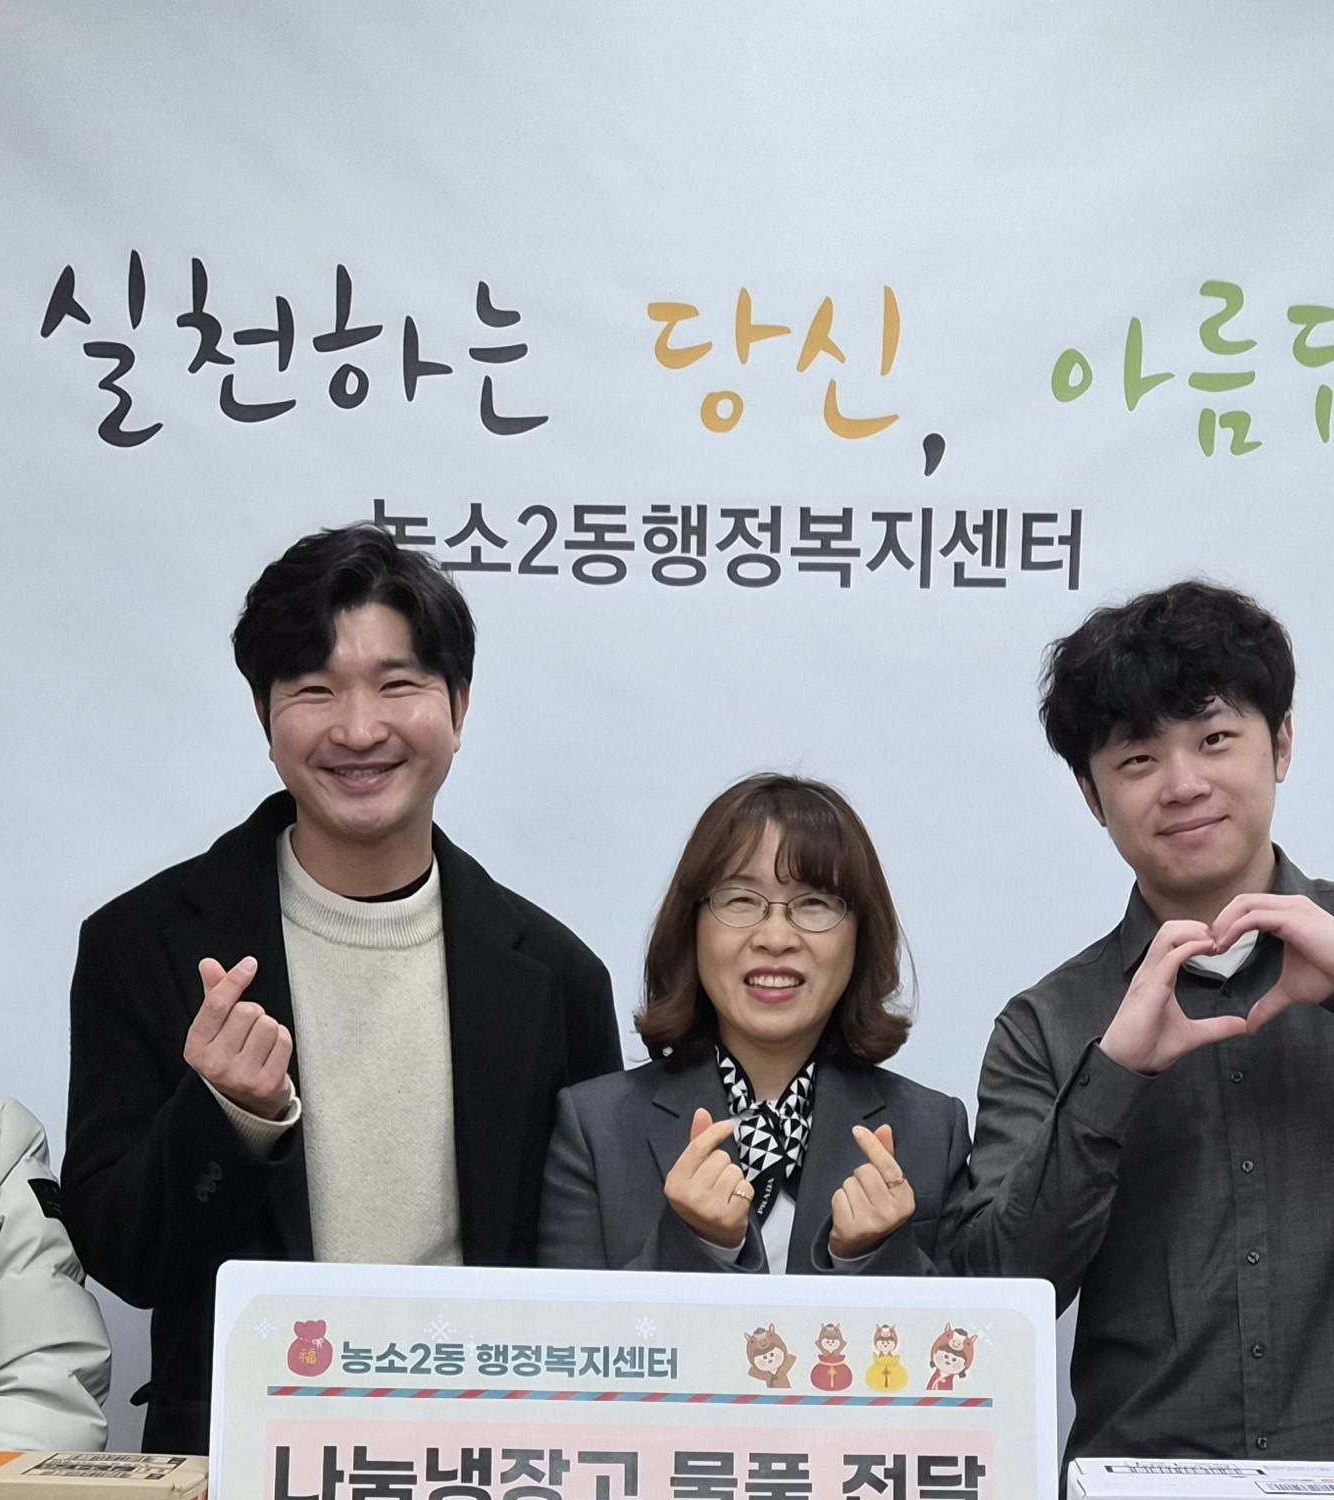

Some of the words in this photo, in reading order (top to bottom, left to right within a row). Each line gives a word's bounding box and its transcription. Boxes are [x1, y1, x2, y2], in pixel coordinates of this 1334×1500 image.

[40, 249, 548, 447] 실천하는
[647, 285, 945, 476] 당신,
[341, 1341, 465, 1376] 농소2동
[476, 1344, 677, 1379] 행정복지센터
